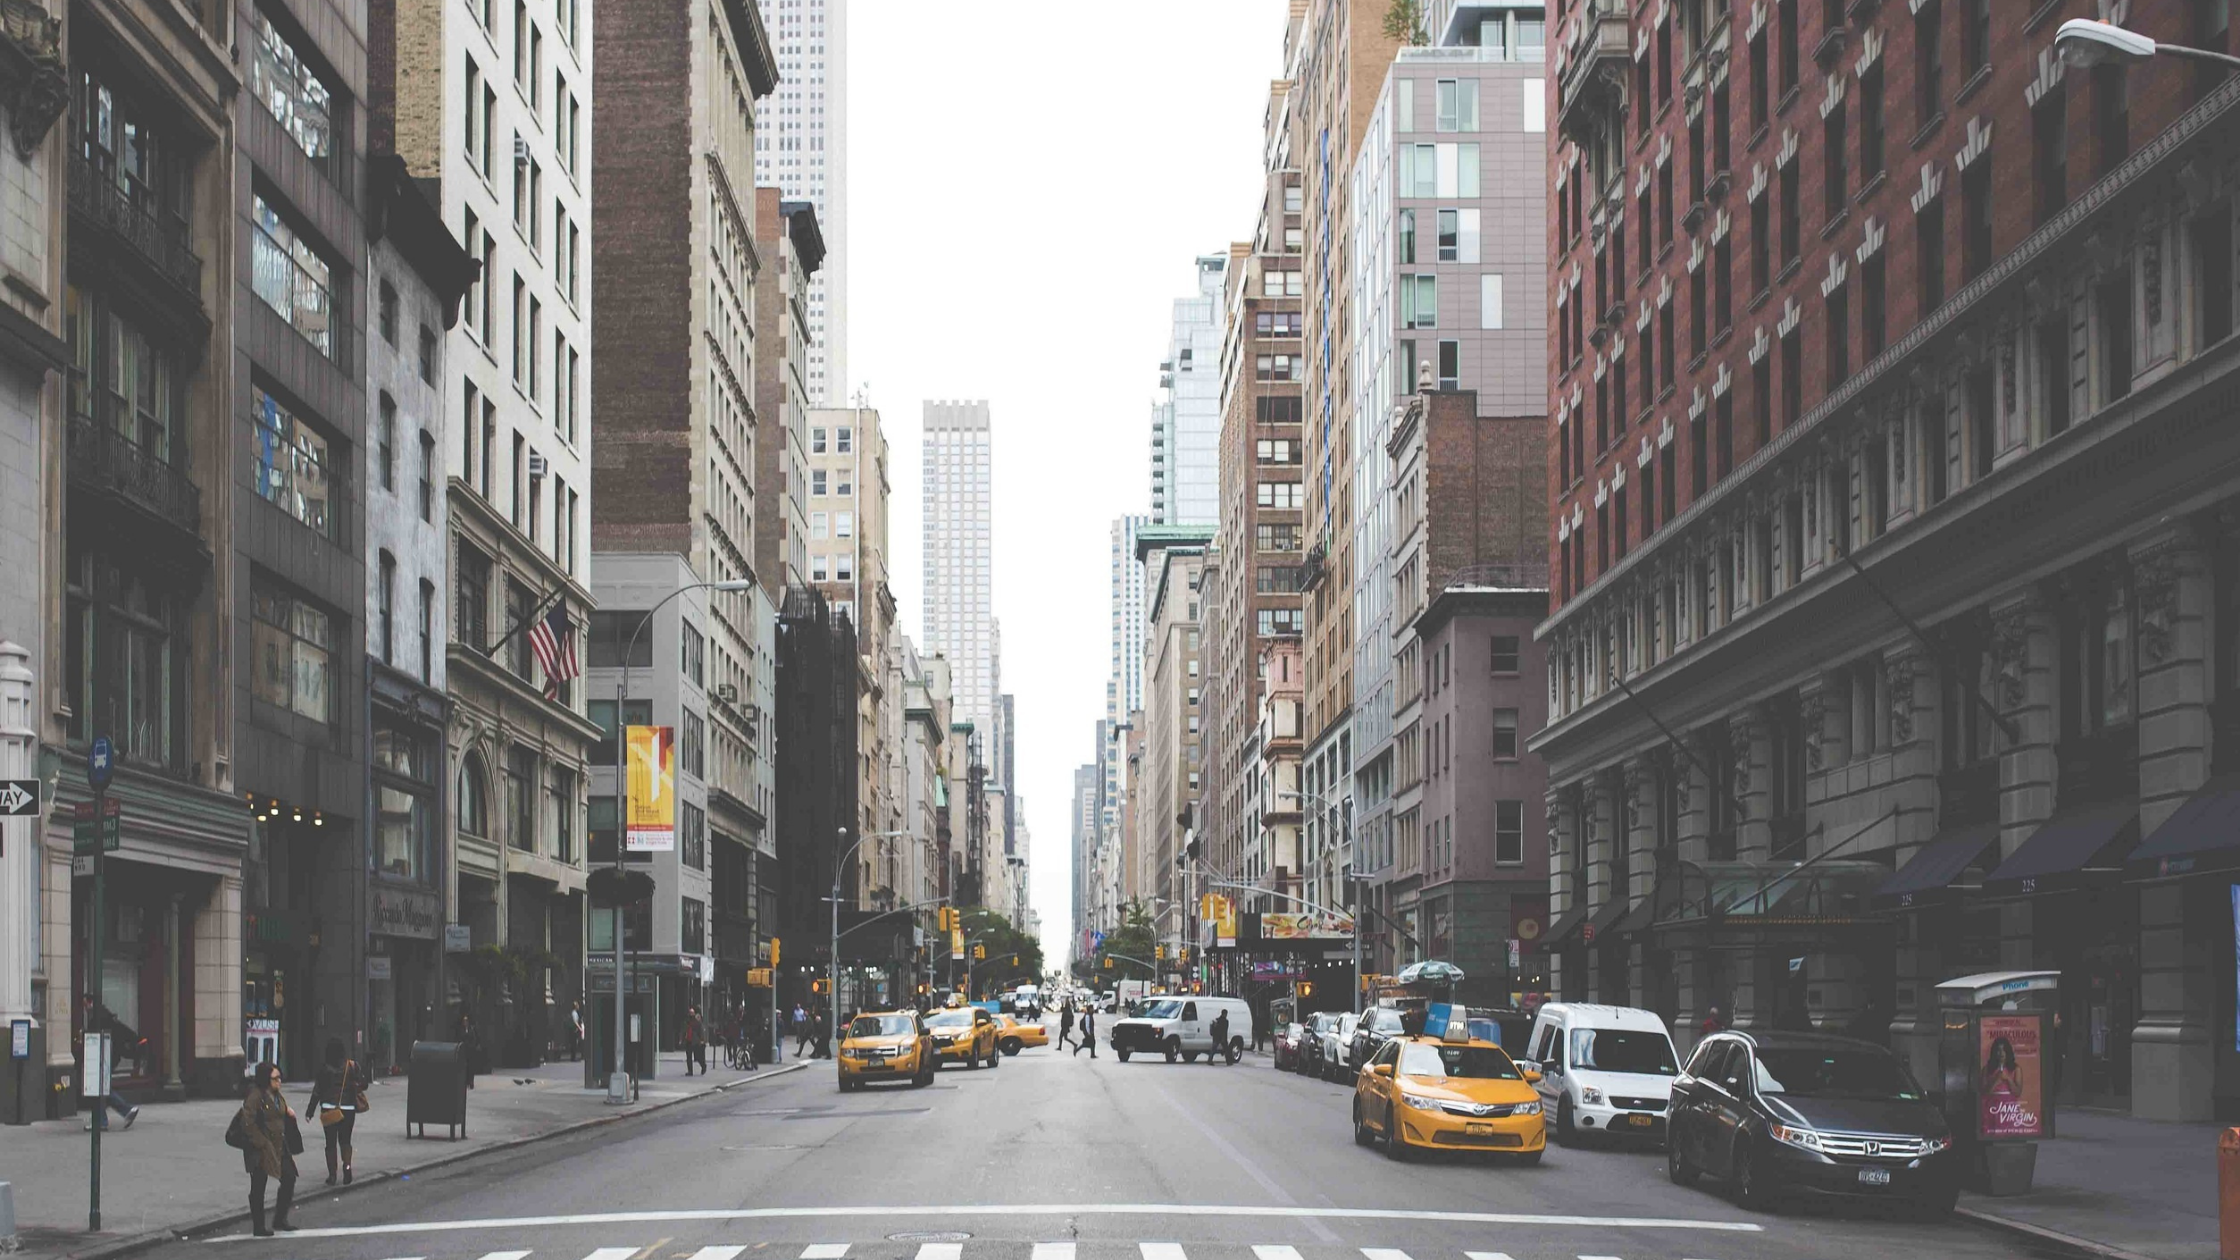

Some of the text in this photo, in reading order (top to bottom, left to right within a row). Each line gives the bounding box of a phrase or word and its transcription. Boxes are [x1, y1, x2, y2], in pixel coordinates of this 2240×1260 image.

[0, 791, 23, 805] AY
[2022, 879, 2035, 892] 225
[1902, 894, 1912, 906] 225
[2002, 981, 2029, 991] Phone
[1990, 1102, 2020, 1114] JANE
[2000, 1112, 2038, 1127] VIRGIN
